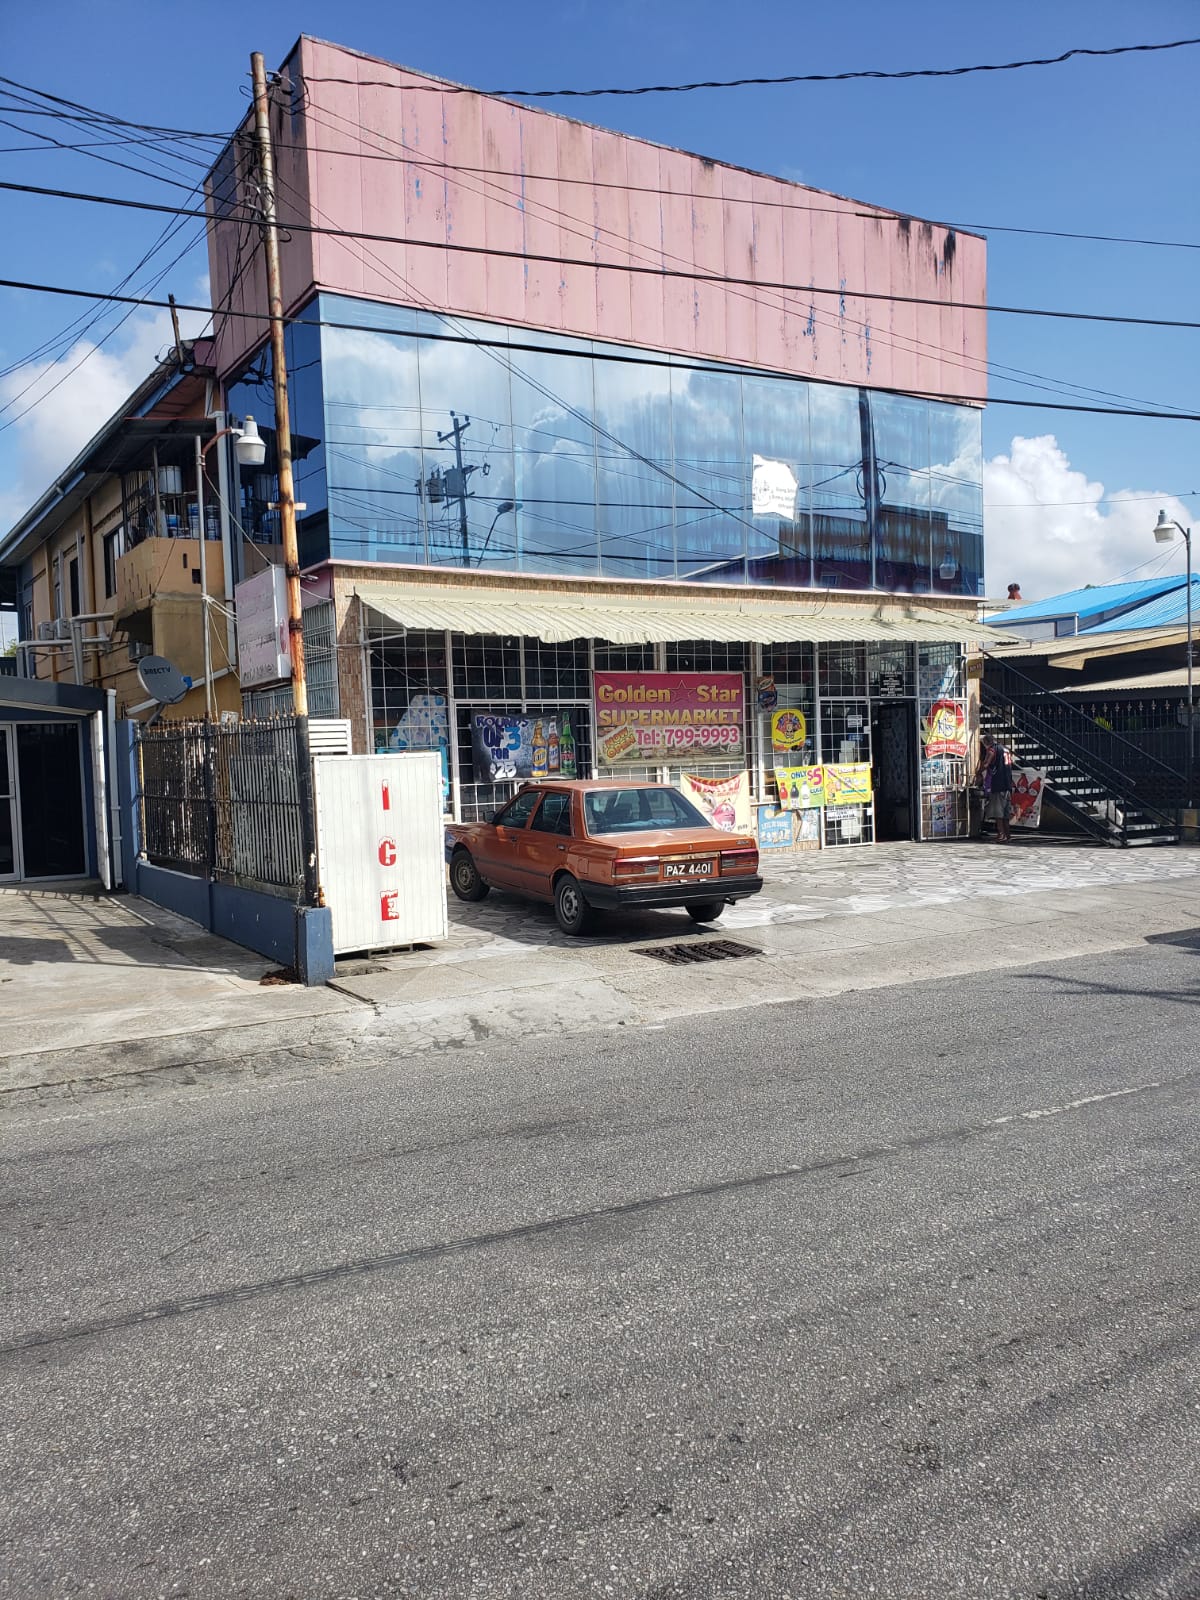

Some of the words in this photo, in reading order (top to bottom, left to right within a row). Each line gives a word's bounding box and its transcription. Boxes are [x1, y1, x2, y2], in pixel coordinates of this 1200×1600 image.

[143, 666, 171, 675] DIRECTV
[598, 684, 671, 703] Golden
[696, 684, 740, 703] Star
[598, 708, 741, 726] SUPERMARKET
[504, 726, 521, 751] 3
[604, 726, 629, 747] NOW
[635, 729, 660, 746] Tel:
[664, 727, 739, 744] 799-9993
[491, 748, 510, 760] FOR
[606, 736, 636, 759] OPEN
[489, 761, 517, 779] $25
[790, 770, 807, 780] ONLY
[807, 767, 823, 786] $5
[378, 779, 399, 922] ICE
[666, 864, 685, 876] PAZ
[688, 863, 711, 875] 4401
